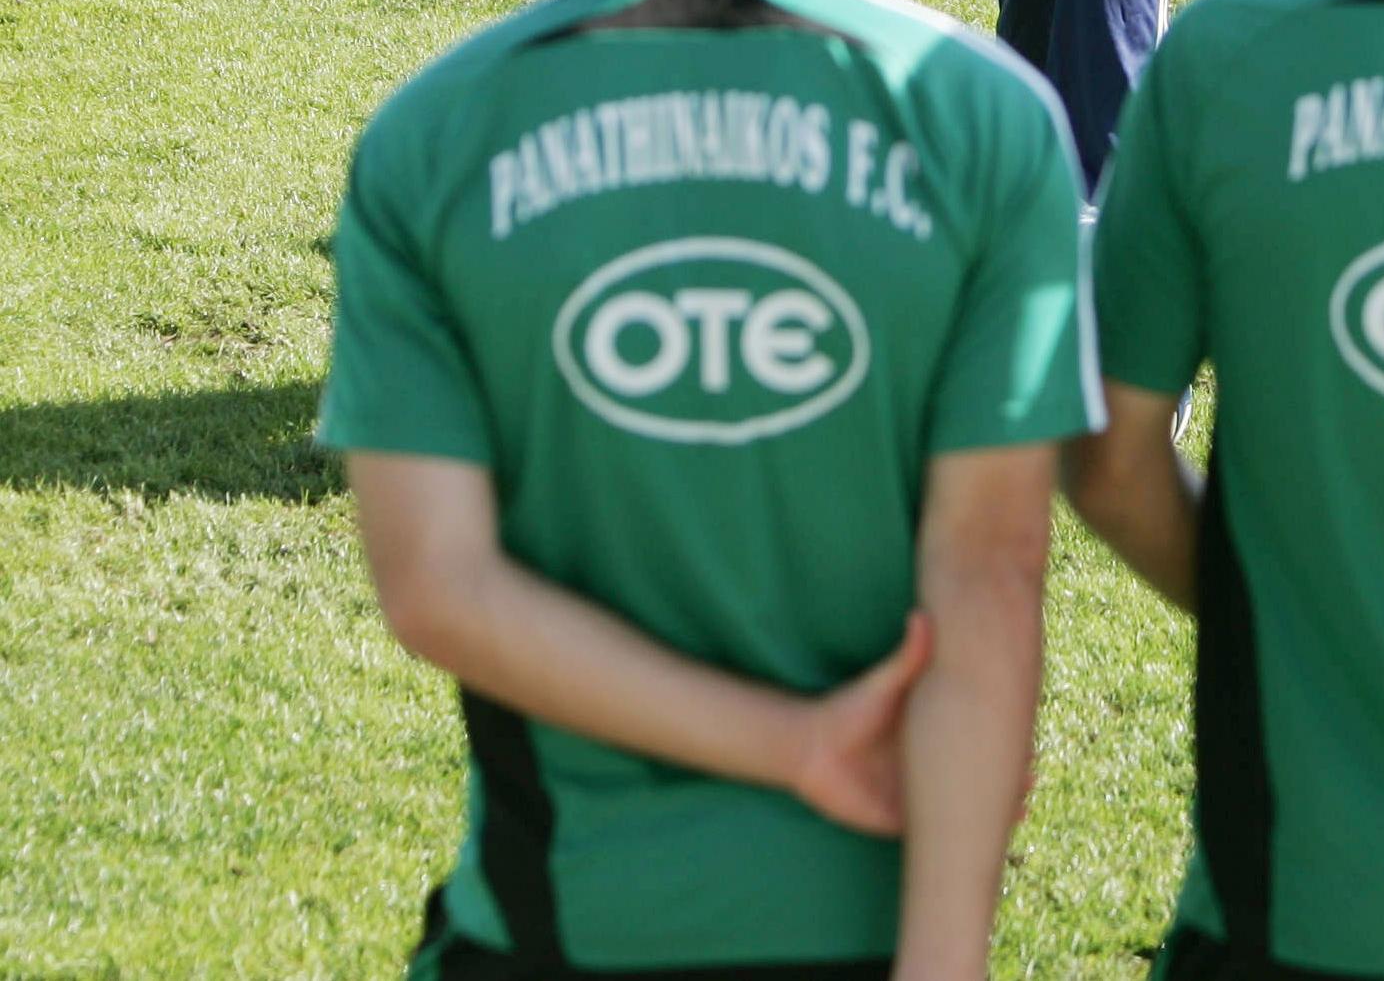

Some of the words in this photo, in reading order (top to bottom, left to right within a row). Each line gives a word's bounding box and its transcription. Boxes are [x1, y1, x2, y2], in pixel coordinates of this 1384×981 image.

[490, 88, 832, 240] PANATHINAIKOS
[845, 118, 934, 241] F.C.
[584, 287, 836, 398] OTE
